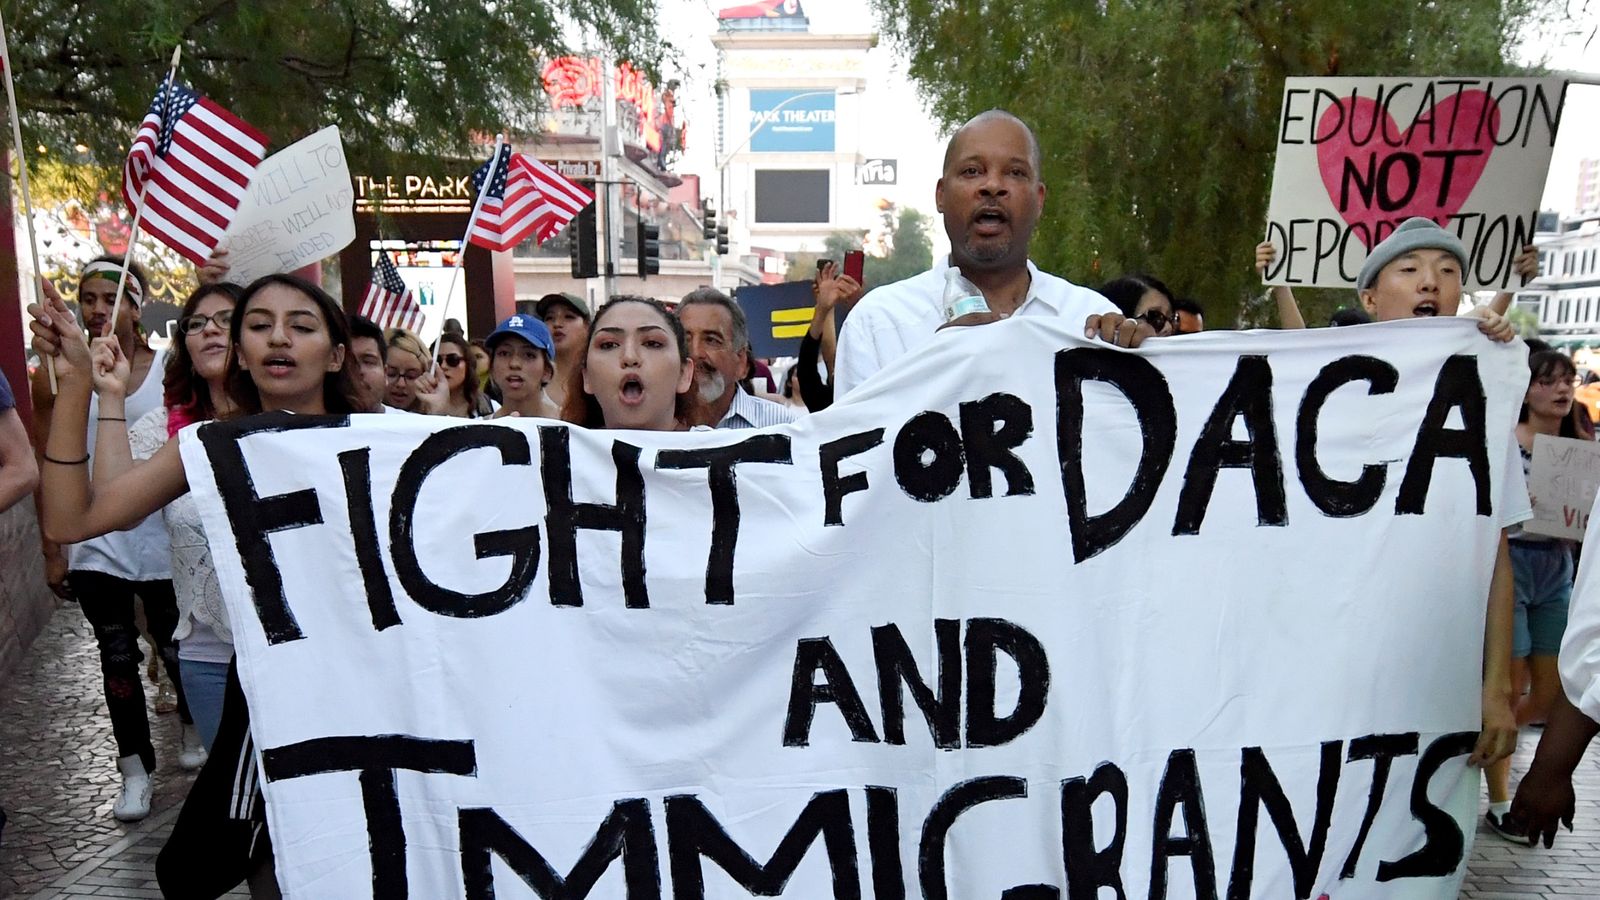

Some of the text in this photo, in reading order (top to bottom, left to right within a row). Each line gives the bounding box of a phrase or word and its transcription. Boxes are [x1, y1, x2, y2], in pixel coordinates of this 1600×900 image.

[750, 109, 835, 122] PARK THEATER
[1281, 80, 1569, 148] EDUCATION
[250, 143, 342, 207] WILL TO
[354, 175, 470, 197] THE PARK
[558, 160, 587, 175] Private
[588, 160, 598, 175] Dr
[1340, 149, 1484, 213] NOT
[282, 200, 330, 235] WILL
[325, 188, 351, 211] NOT
[272, 232, 336, 271] ENDED
[1264, 210, 1538, 288] DEPOTION
[197, 347, 1492, 646] FIGHT FOR DACA
[783, 616, 1050, 751] AND
[262, 731, 1480, 900] IMMIGRANTS
